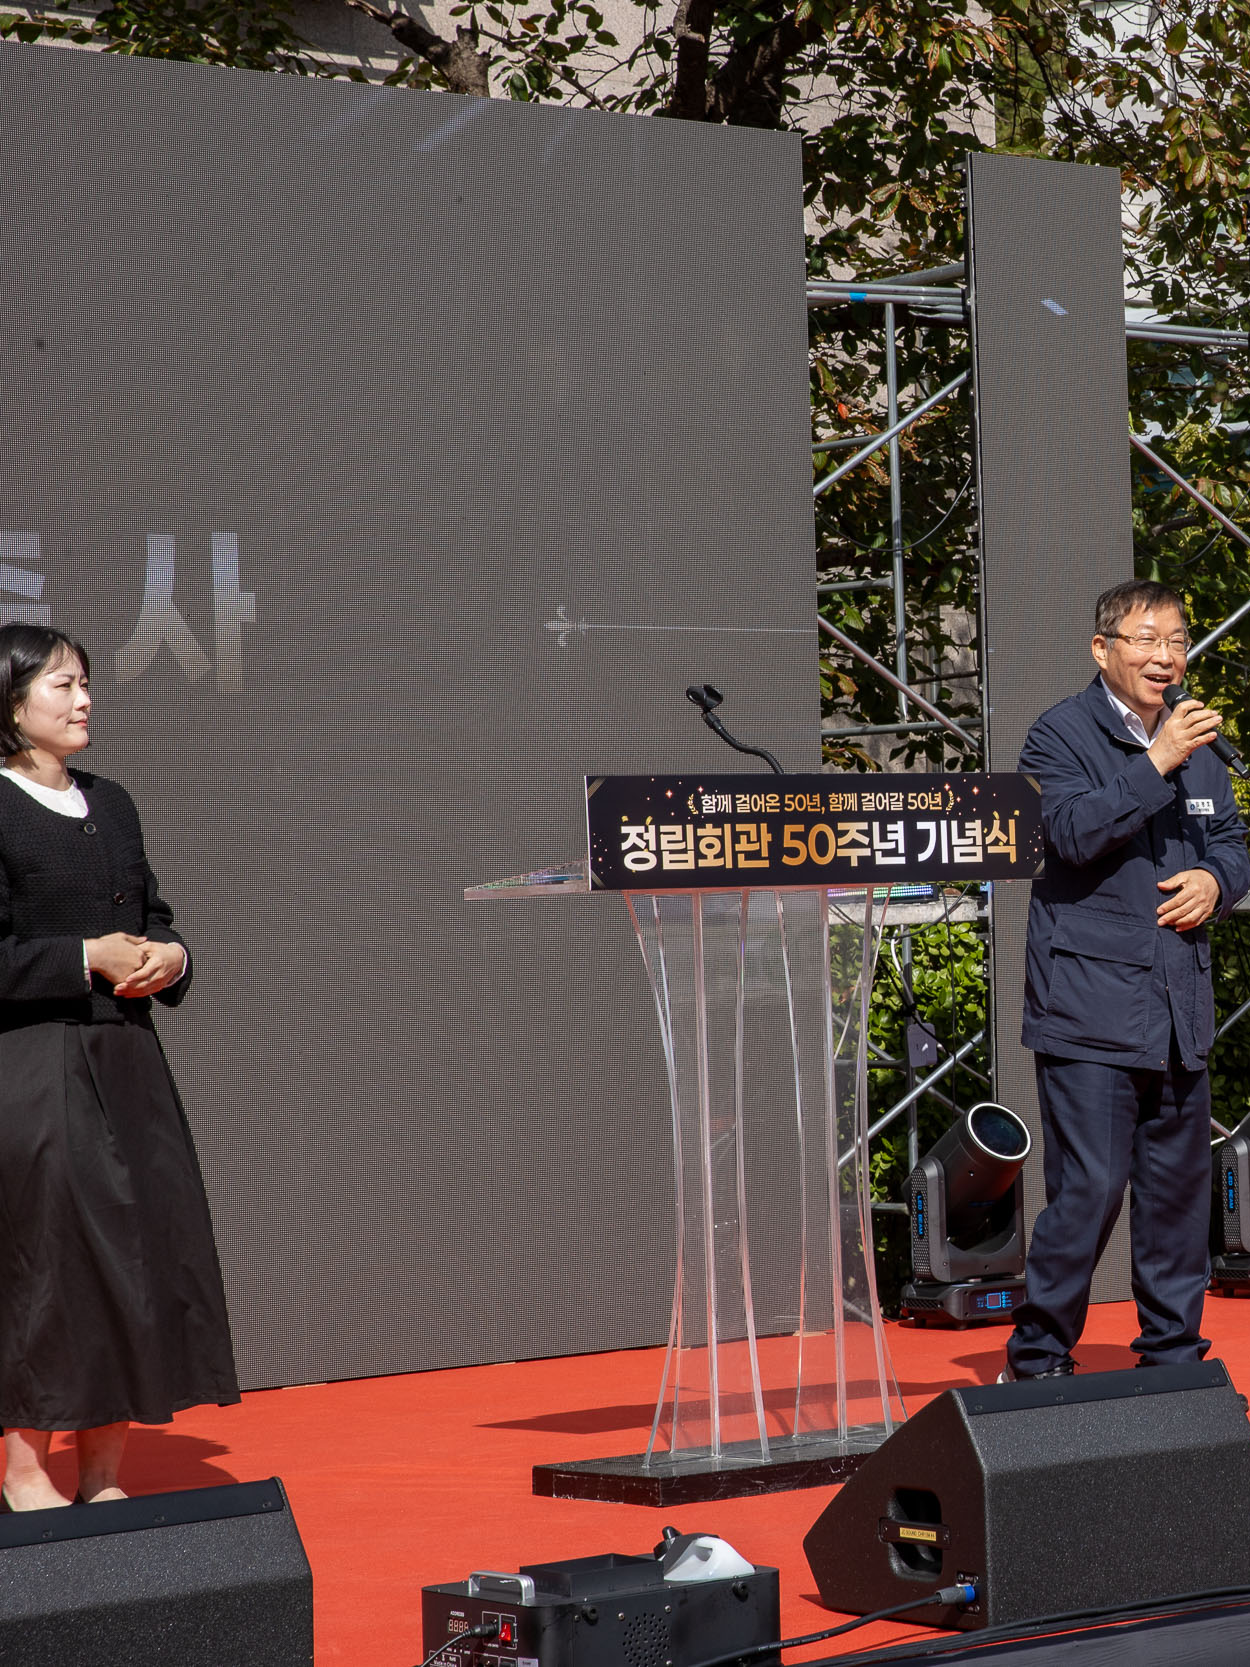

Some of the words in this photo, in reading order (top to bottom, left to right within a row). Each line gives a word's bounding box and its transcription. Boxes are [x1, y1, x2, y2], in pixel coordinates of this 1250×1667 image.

[701, 794, 732, 814] 함께
[736, 793, 780, 813] 걸어온
[784, 793, 826, 814] 50년,
[829, 793, 859, 812] 함께
[862, 792, 903, 812] 걸어갈
[907, 791, 942, 811] 50년
[620, 822, 771, 871] 정립회관
[782, 819, 905, 867] 50주년
[917, 818, 1017, 863] 기념식
